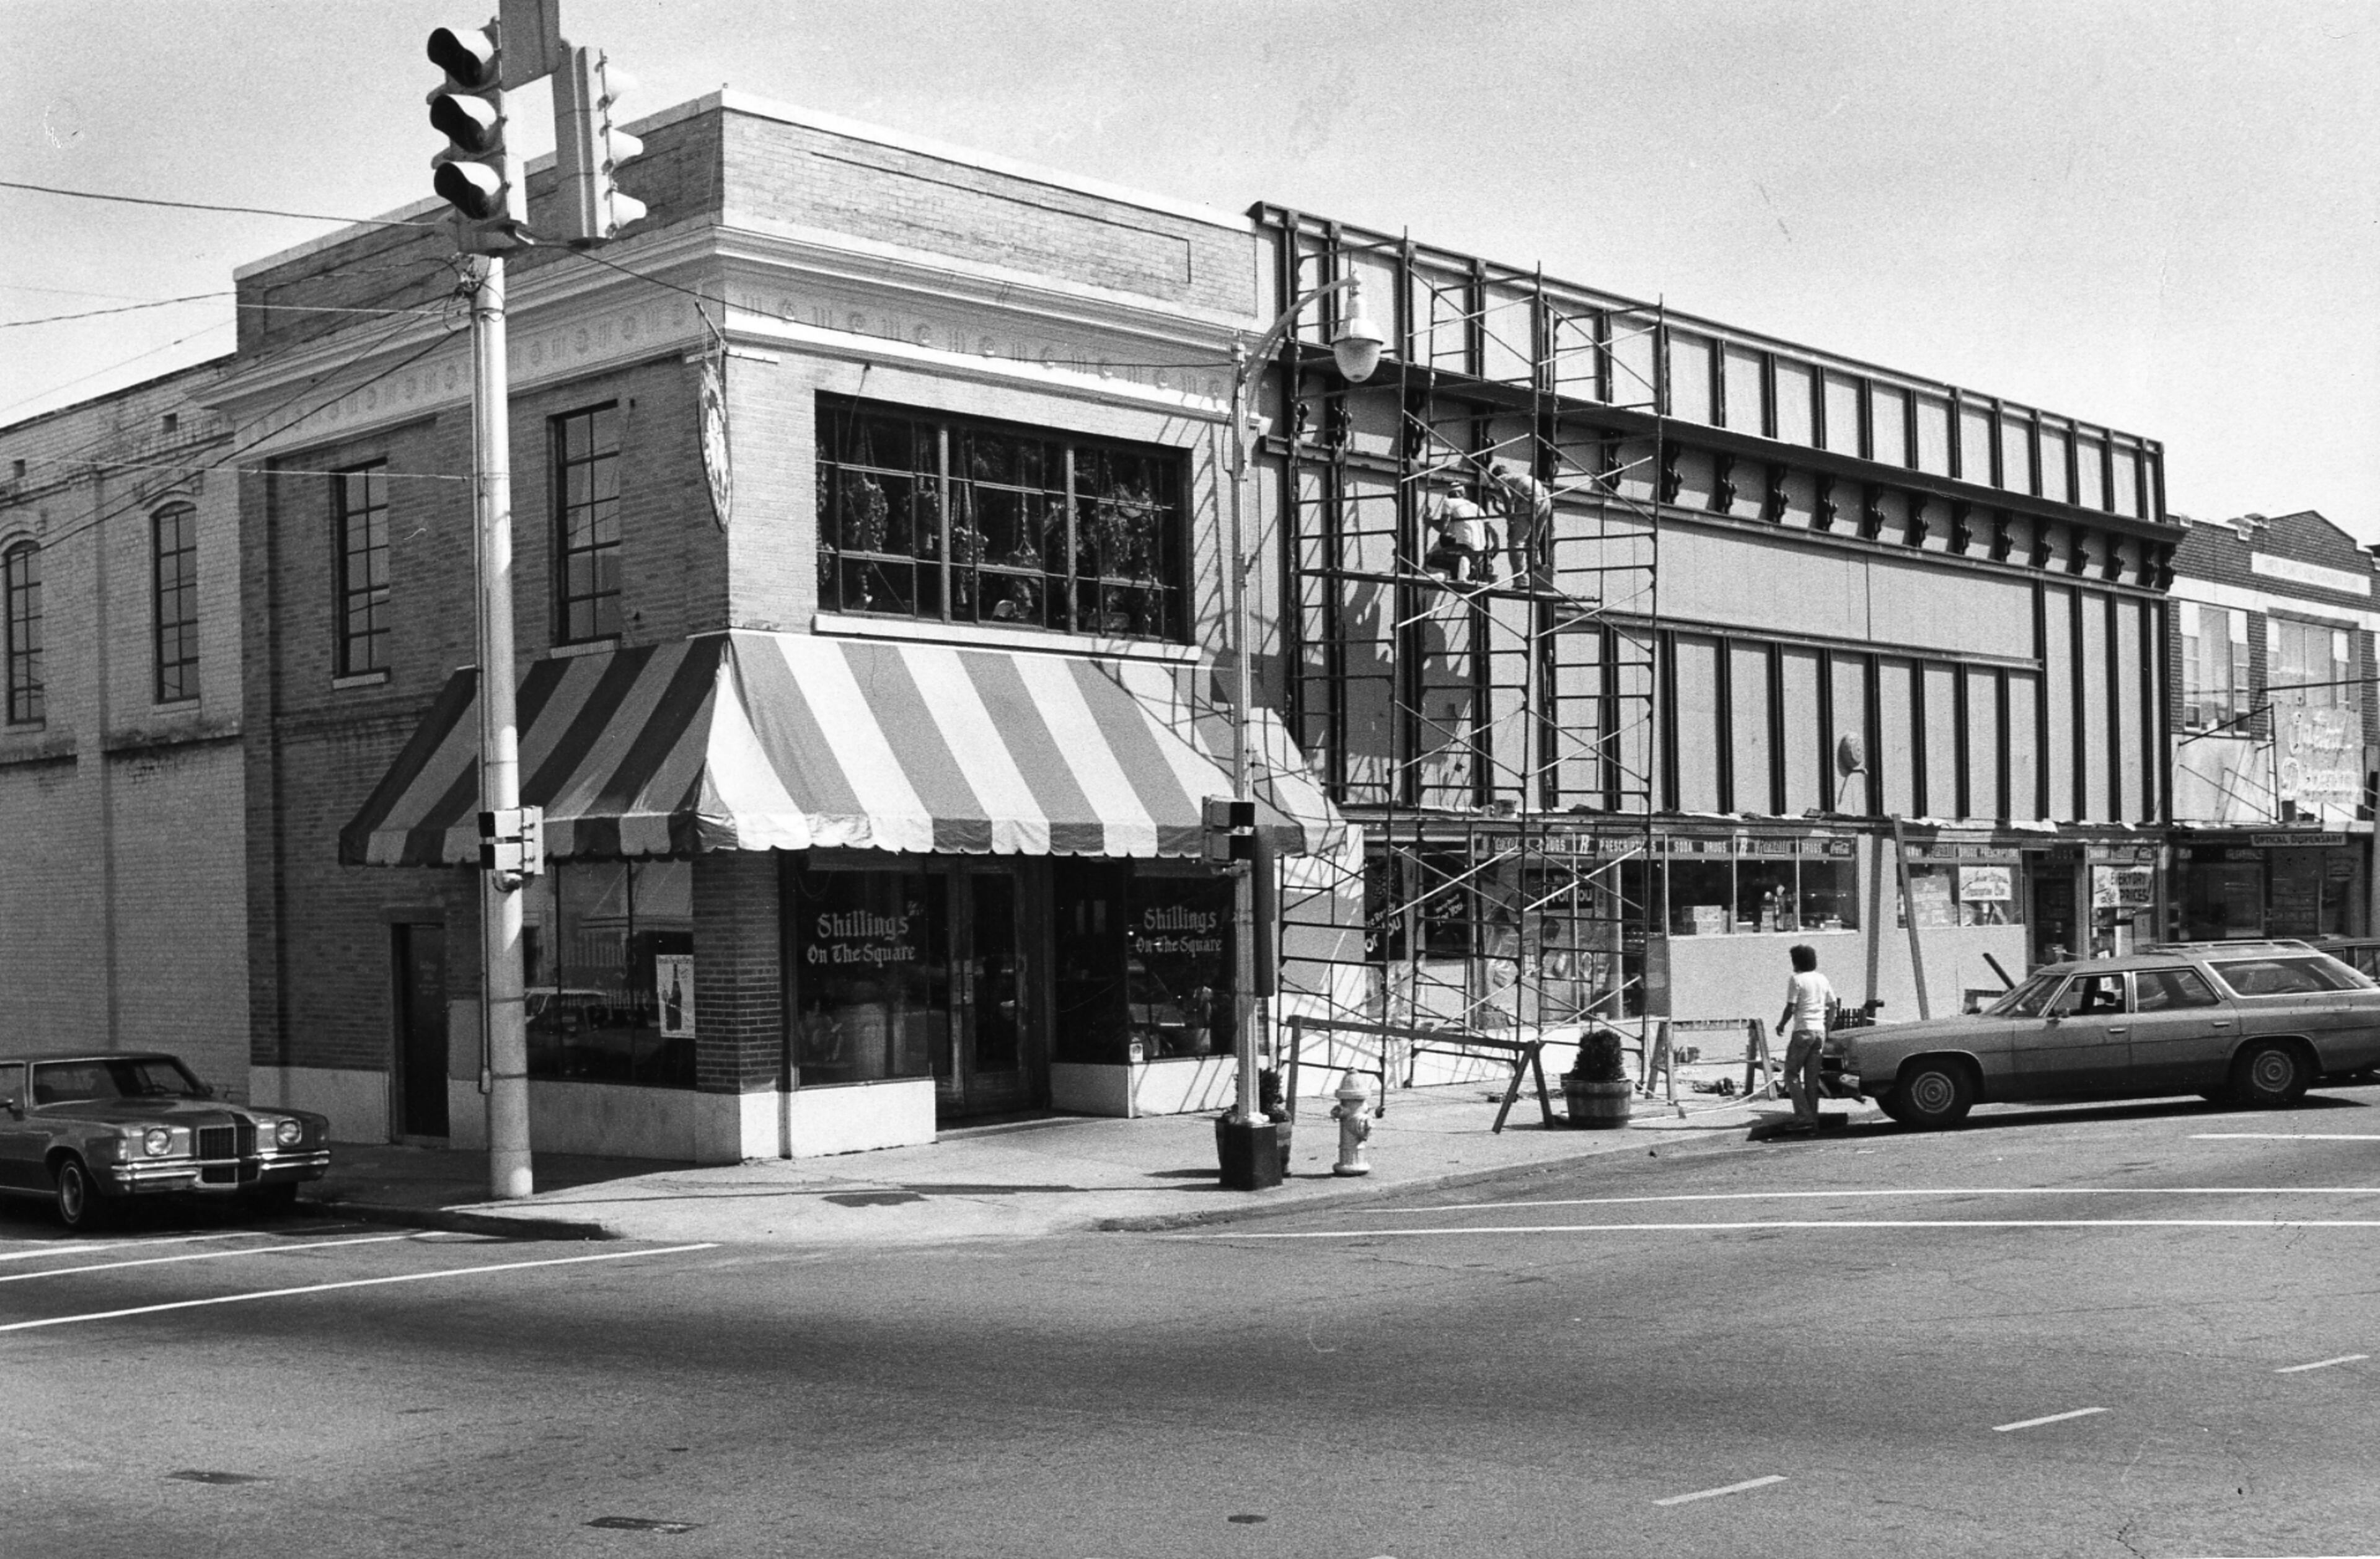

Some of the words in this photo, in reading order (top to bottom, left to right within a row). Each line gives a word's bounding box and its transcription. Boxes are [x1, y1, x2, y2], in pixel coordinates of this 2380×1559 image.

[2254, 834, 2288, 844] OPTICAL
[2291, 834, 2343, 844] DISPENSARY
[817, 909, 910, 942] Shillings
[1144, 905, 1217, 934] Shillings
[807, 943, 828, 966] On
[831, 942, 862, 964] The
[862, 942, 916, 969] Square
[1135, 935, 1153, 954] On
[1155, 934, 1178, 953] The
[1179, 935, 1223, 959] Square
